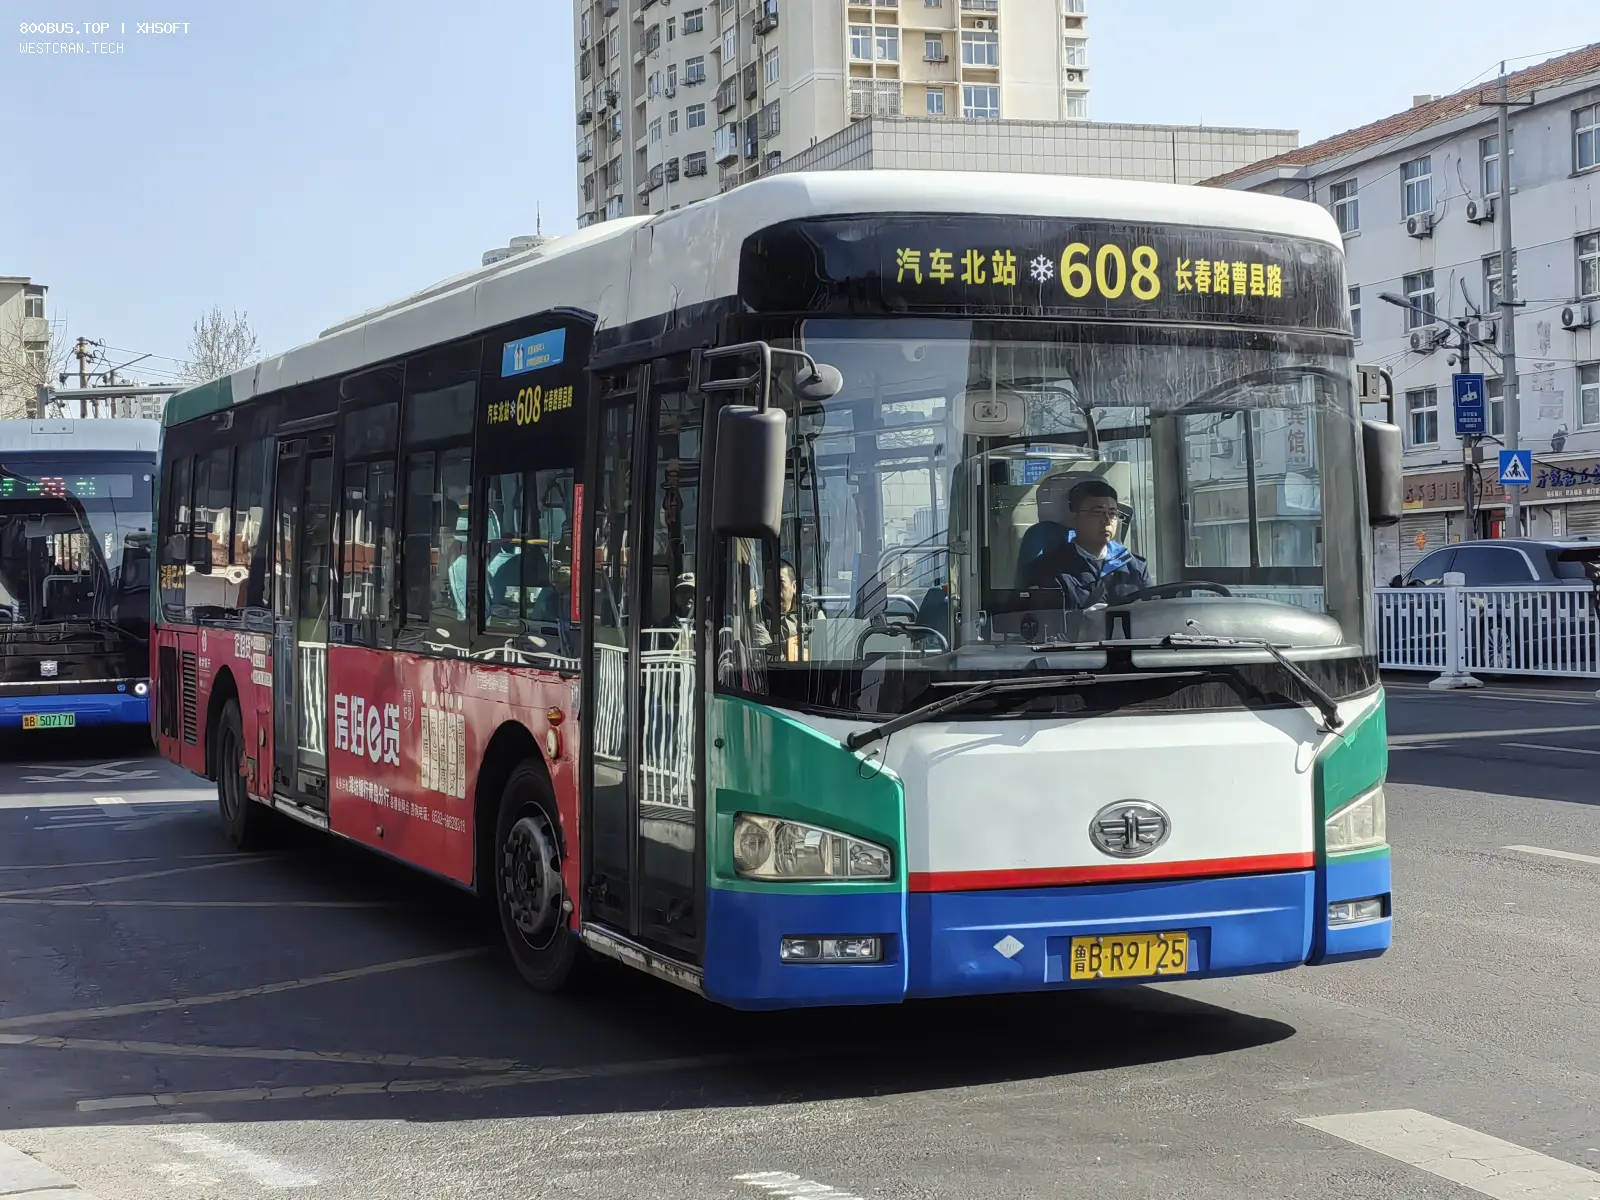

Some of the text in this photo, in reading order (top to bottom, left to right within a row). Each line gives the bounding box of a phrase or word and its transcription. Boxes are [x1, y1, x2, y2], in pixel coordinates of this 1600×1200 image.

[896, 242, 1283, 300] 汽车北站 608 长春路曹县路
[516, 385, 542, 426] 608
[1073, 938, 1185, 974] 鲁B·R9125
